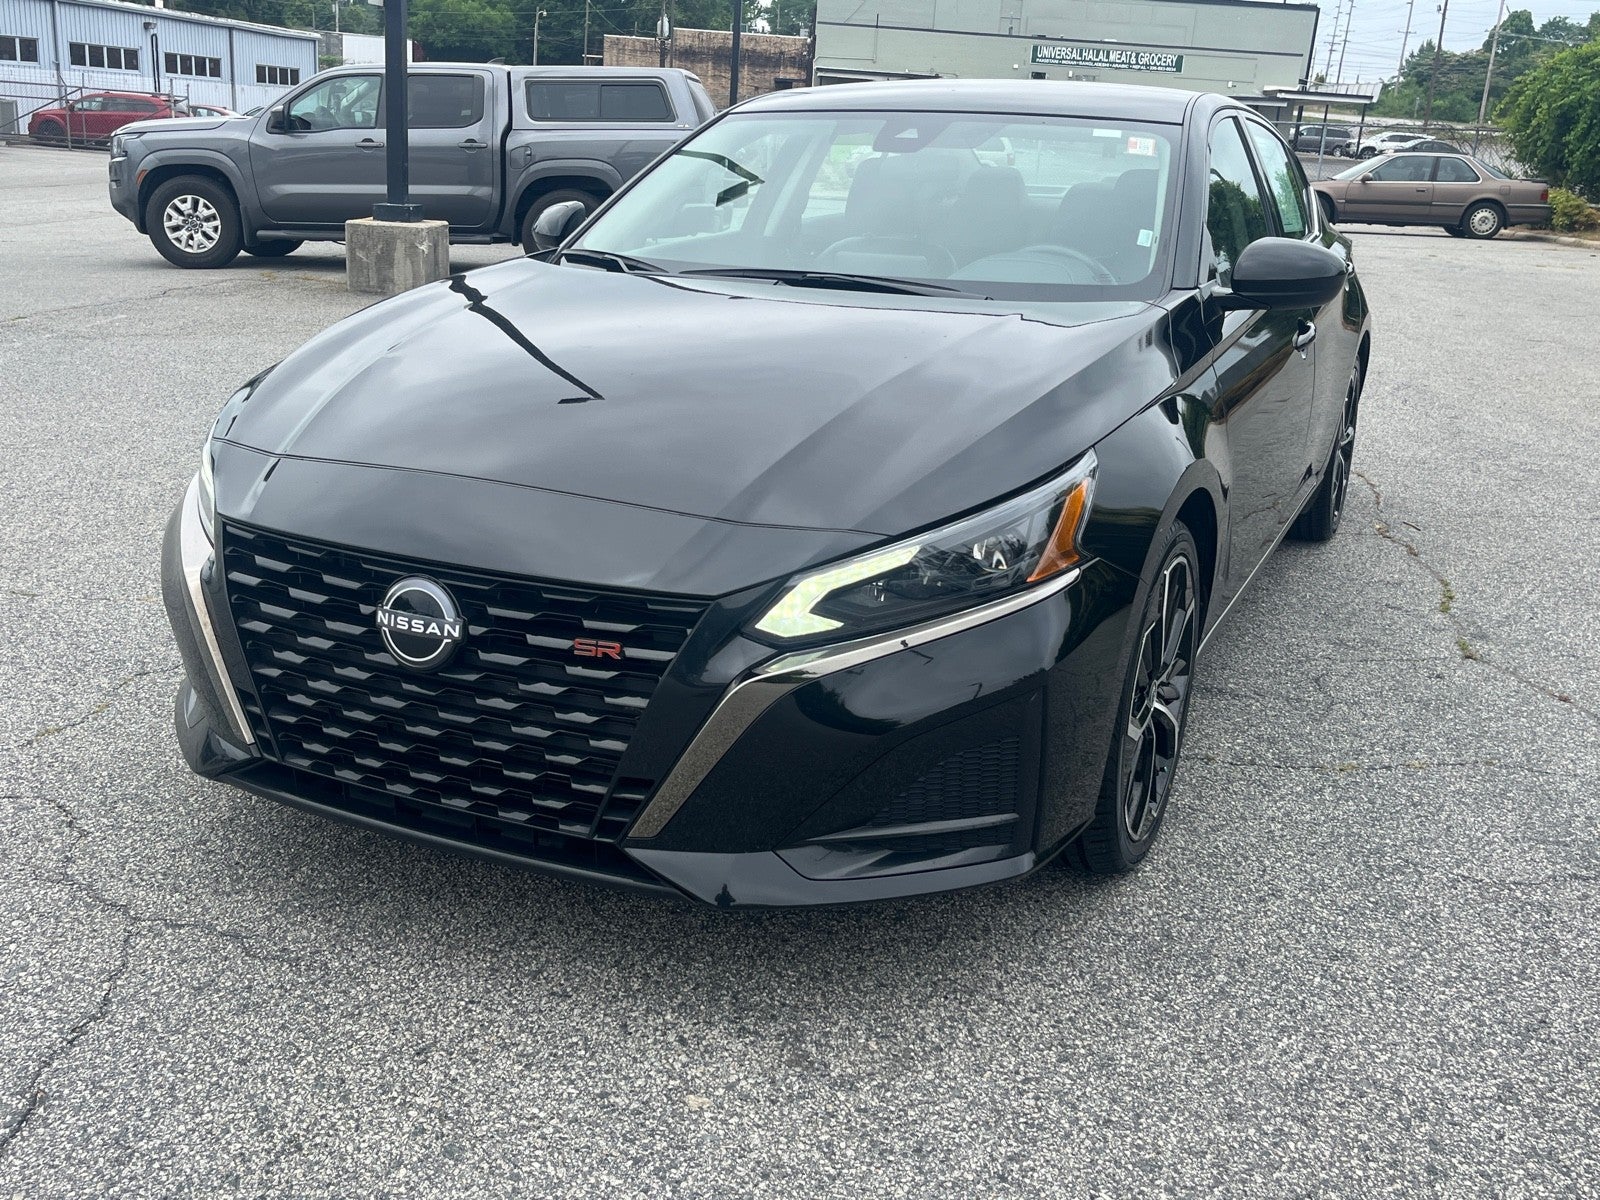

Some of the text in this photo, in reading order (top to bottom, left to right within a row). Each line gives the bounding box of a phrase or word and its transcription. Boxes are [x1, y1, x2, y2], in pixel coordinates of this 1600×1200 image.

[1037, 46, 1081, 60] UNIVERSAL
[1082, 48, 1108, 62] HALAL
[1138, 52, 1178, 67] GROCERY
[376, 610, 460, 638] NISSAN
[573, 638, 622, 660] SR
